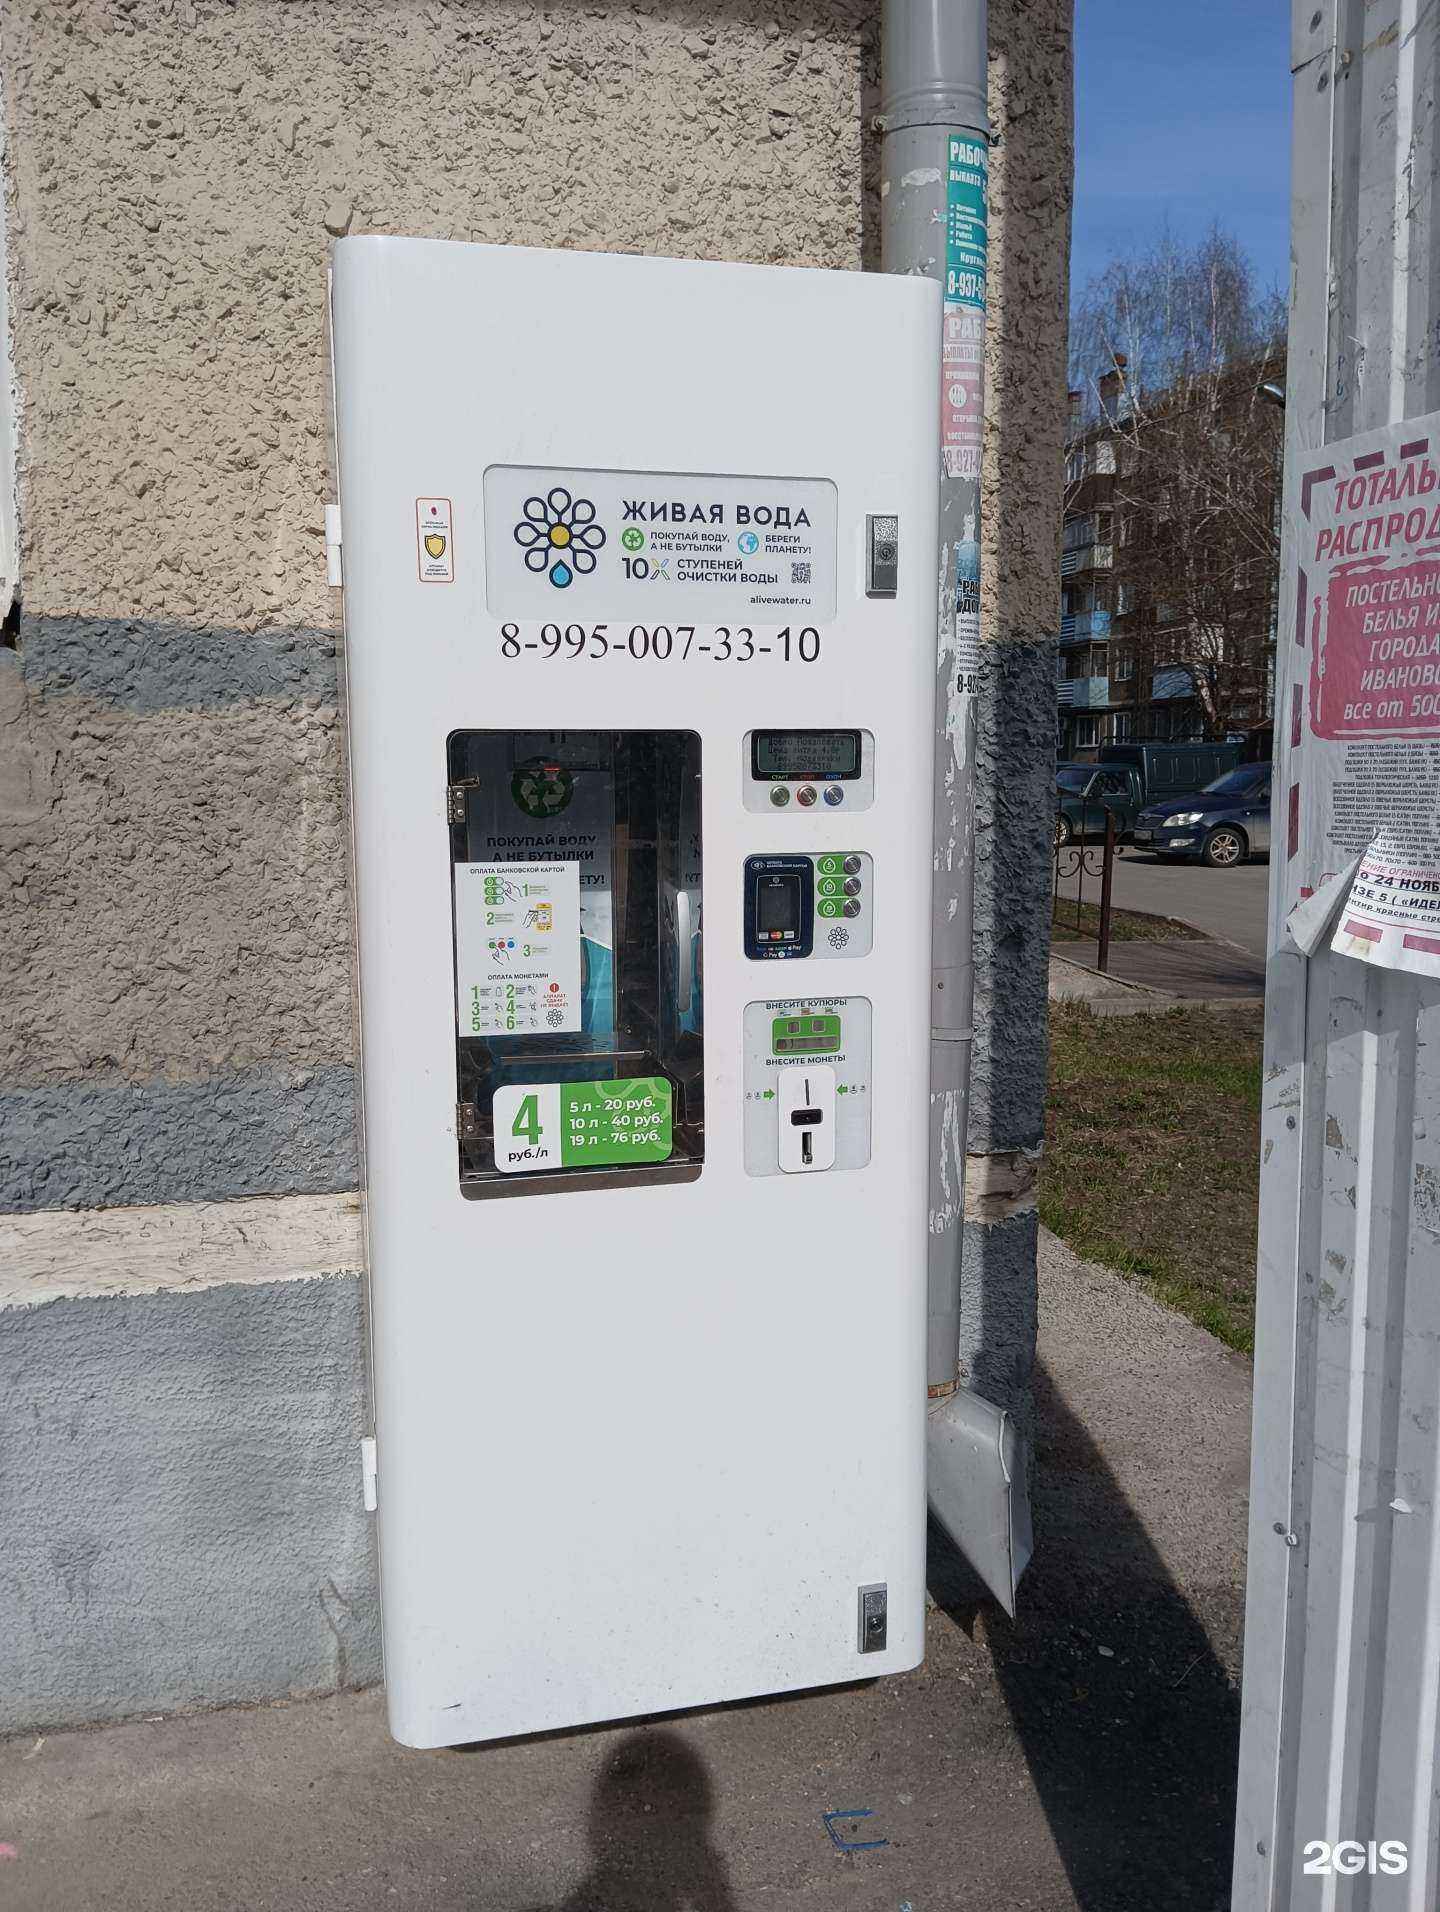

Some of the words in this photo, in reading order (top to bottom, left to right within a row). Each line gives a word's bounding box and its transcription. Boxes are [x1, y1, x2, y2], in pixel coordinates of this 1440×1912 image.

[1335, 460, 1440, 514] ТОТАЛЬ
[622, 501, 724, 523] ЖИВАЯ
[736, 505, 811, 529] ВОДА
[651, 531, 698, 542] ПОКУПАЙ
[701, 534, 730, 543] ВОДУ,
[765, 534, 800, 544] БЕРЕГИ
[651, 543, 658, 551] А
[661, 543, 673, 551] НЕ
[676, 544, 722, 552] БУТЫЛКИ
[765, 546, 812, 554] ПЛАНЕТУ!
[677, 558, 743, 570] СТУПЕНЕЙ
[677, 572, 737, 582] ОЧИСТКИ
[741, 574, 778, 584] ВОДЫ
[750, 595, 812, 605] alivewater.ru
[1362, 606, 1420, 634] БЕЛЬЯ
[1425, 602, 1440, 626] И
[500, 623, 821, 662] 8-995-007-33-10
[1344, 703, 1372, 720] все
[487, 834, 555, 848] ПОКУПАЙ
[559, 835, 597, 847] ВОДУ
[507, 852, 525, 862] НЕ
[528, 850, 594, 861] БУТЫЛКИ
[1360, 860, 1388, 874] ЕНИЕ
[579, 874, 605, 885] ЕТУ!
[1374, 874, 1394, 886] 24
[522, 884, 528, 896] 1
[1380, 893, 1388, 902] 5
[1402, 898, 1440, 910] «ИДЕ
[486, 912, 494, 925] 2
[523, 944, 530, 957] 3
[471, 986, 478, 999] 1
[506, 984, 514, 998] 2
[472, 1002, 480, 1016] 3
[506, 1000, 515, 1014] 4
[766, 1001, 806, 1010] ВНЕСИТЕ
[808, 999, 847, 1008] КУПЮРЫ
[472, 1017, 480, 1031] 5
[506, 1016, 515, 1030] 6
[766, 1057, 806, 1066] ВНЕСИТЕ
[808, 1055, 846, 1064] МОНЕТЫ
[570, 1102, 578, 1112] 5
[582, 1104, 592, 1112] л
[604, 1099, 622, 1110] 20
[626, 1096, 656, 1110] руб.
[512, 1094, 543, 1145] 4
[570, 1118, 585, 1130] 10
[588, 1118, 598, 1128] л
[611, 1116, 630, 1126] 40
[634, 1112, 664, 1127] руб.
[570, 1135, 585, 1146] 19
[588, 1134, 598, 1145] л
[611, 1132, 628, 1143] 76
[632, 1130, 661, 1144] руб.
[508, 1148, 548, 1162] руб./л
